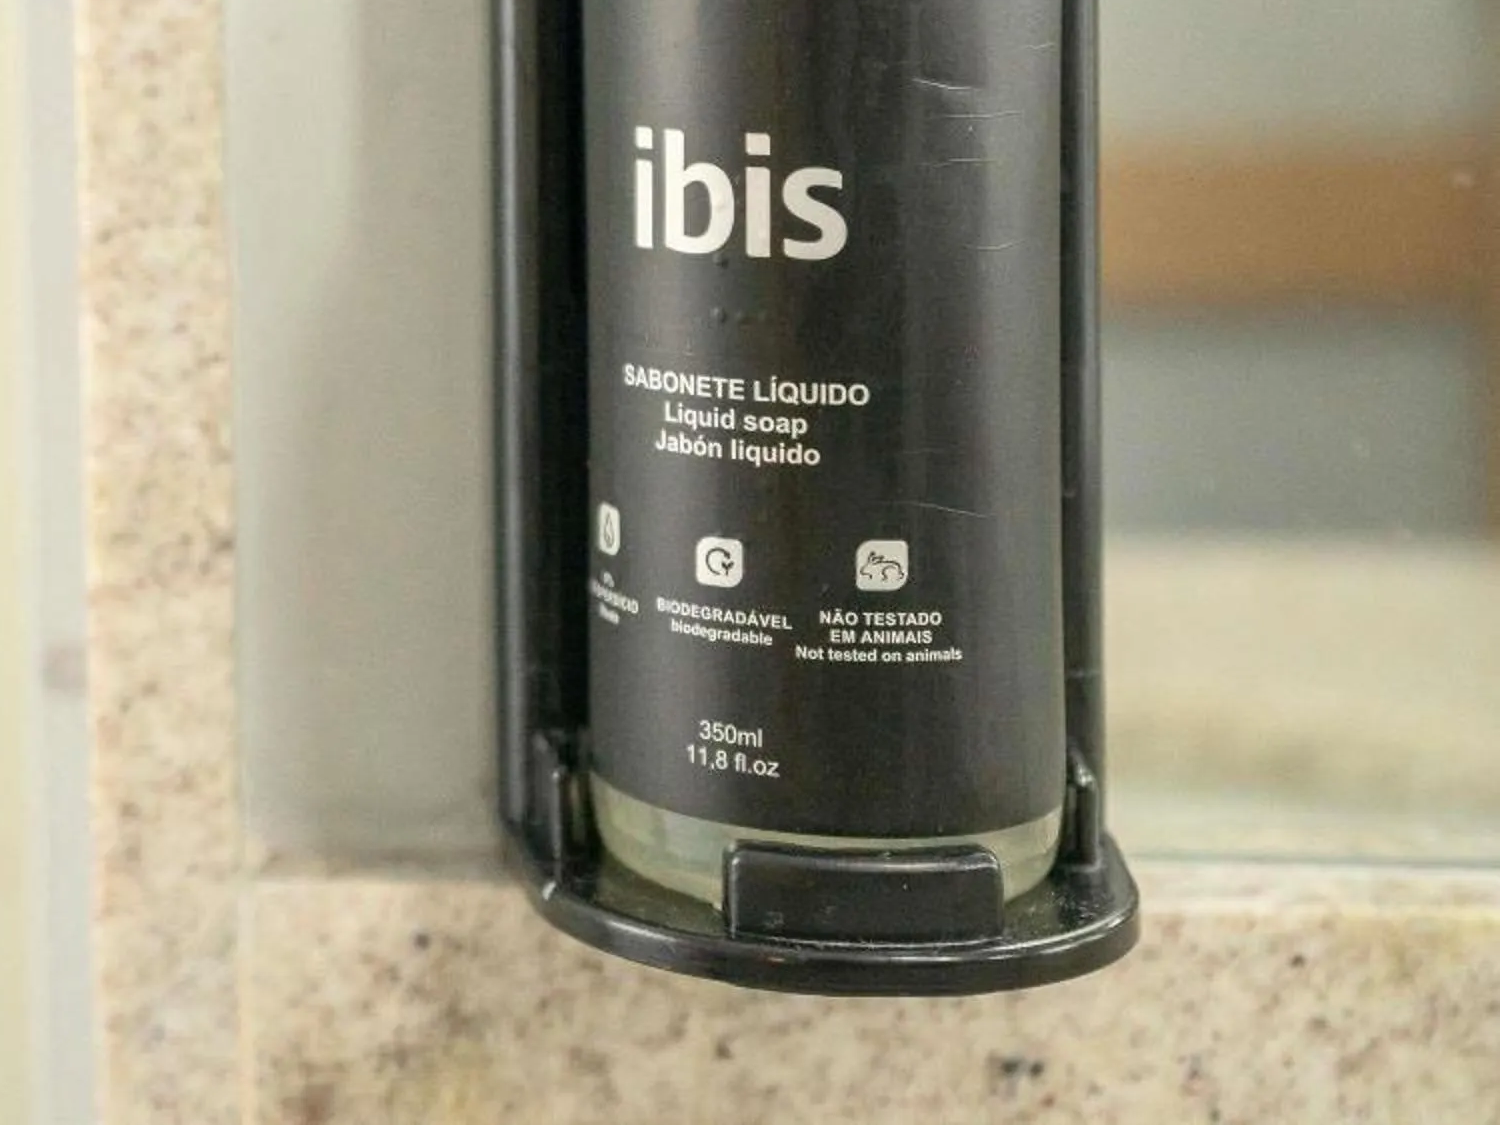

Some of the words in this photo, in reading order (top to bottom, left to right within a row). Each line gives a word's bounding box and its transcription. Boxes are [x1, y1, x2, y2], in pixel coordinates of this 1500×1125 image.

[634, 126, 849, 261] ibis
[623, 363, 745, 401] SABONETE
[752, 376, 871, 406] LÍQUIDO
[664, 401, 735, 431] Liquid
[743, 415, 809, 439] soap
[655, 428, 723, 460] Jabón
[656, 596, 793, 631] BIODEGRADÁVEL
[819, 608, 859, 626] NÃO
[863, 612, 943, 626] TESTADO
[671, 618, 774, 647] biodegradable
[830, 629, 856, 644] EM
[860, 630, 933, 645] ANIMAIS
[795, 645, 825, 661] Not
[827, 647, 878, 663] tested
[881, 652, 902, 663] on
[905, 647, 963, 663] animals
[699, 719, 764, 748] 350ml
[686, 744, 729, 771] 11,8
[735, 752, 781, 778] fl.oz
